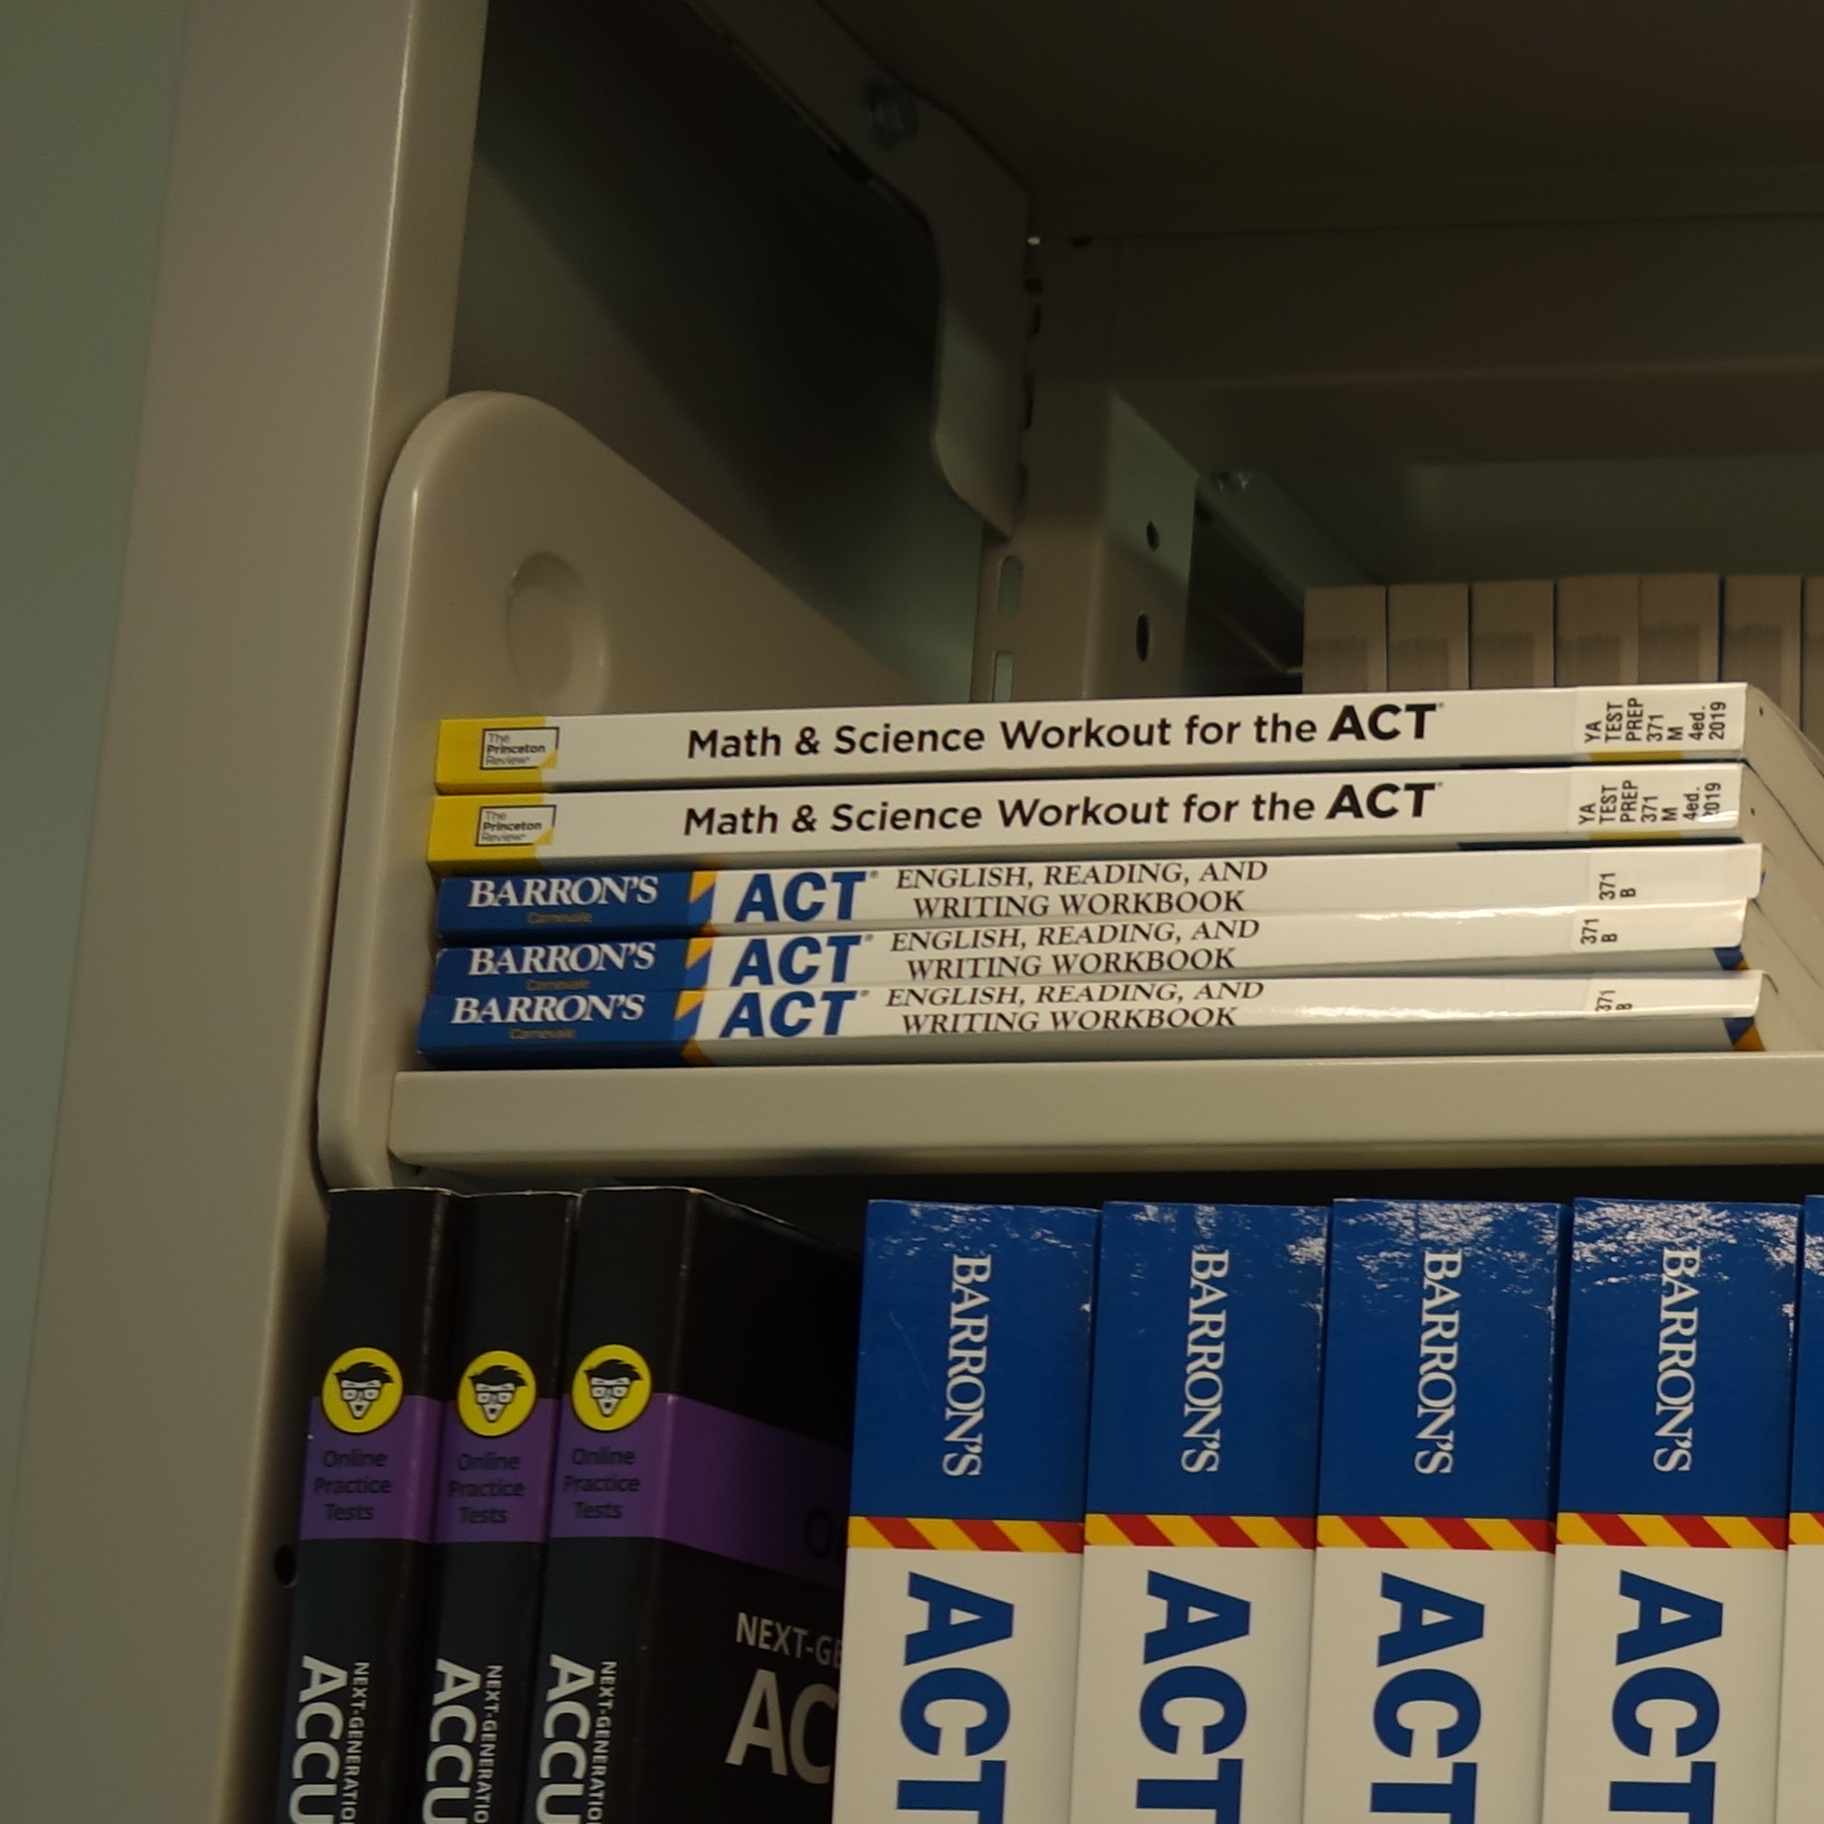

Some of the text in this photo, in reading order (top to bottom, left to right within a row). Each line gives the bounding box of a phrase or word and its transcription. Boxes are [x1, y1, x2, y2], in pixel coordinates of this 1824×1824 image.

[1584, 720, 1602, 743] YA
[1604, 701, 1624, 743] TEST
[1624, 696, 1644, 742] PREP
[1645, 714, 1664, 743] 371
[1666, 726, 1684, 741] M
[1687, 705, 1706, 742] 4ed.
[1707, 701, 1727, 741] 2019
[687, 726, 782, 759] Math
[794, 726, 820, 756] &
[834, 722, 985, 755] Science
[999, 717, 1172, 750] Workout
[1184, 714, 1242, 746] for
[1253, 712, 1318, 744] the
[683, 804, 779, 836] Math
[791, 804, 817, 834] &
[830, 801, 983, 833] Science
[997, 796, 1170, 828] Workout
[1182, 793, 1240, 824] for
[1251, 791, 1316, 822] the
[896, 860, 1268, 889] ENGLISH, READING, AND
[1598, 872, 1617, 901] 371
[468, 875, 659, 908] BARRON'S
[913, 890, 1245, 920] WRITING WORKBOOK
[1619, 887, 1637, 899] B
[942, 1254, 992, 1477] BARRON'S
[1181, 1249, 1230, 1473] BARRON'S
[561, 1474, 642, 1493] Practice
[572, 1500, 623, 1520] Tests
